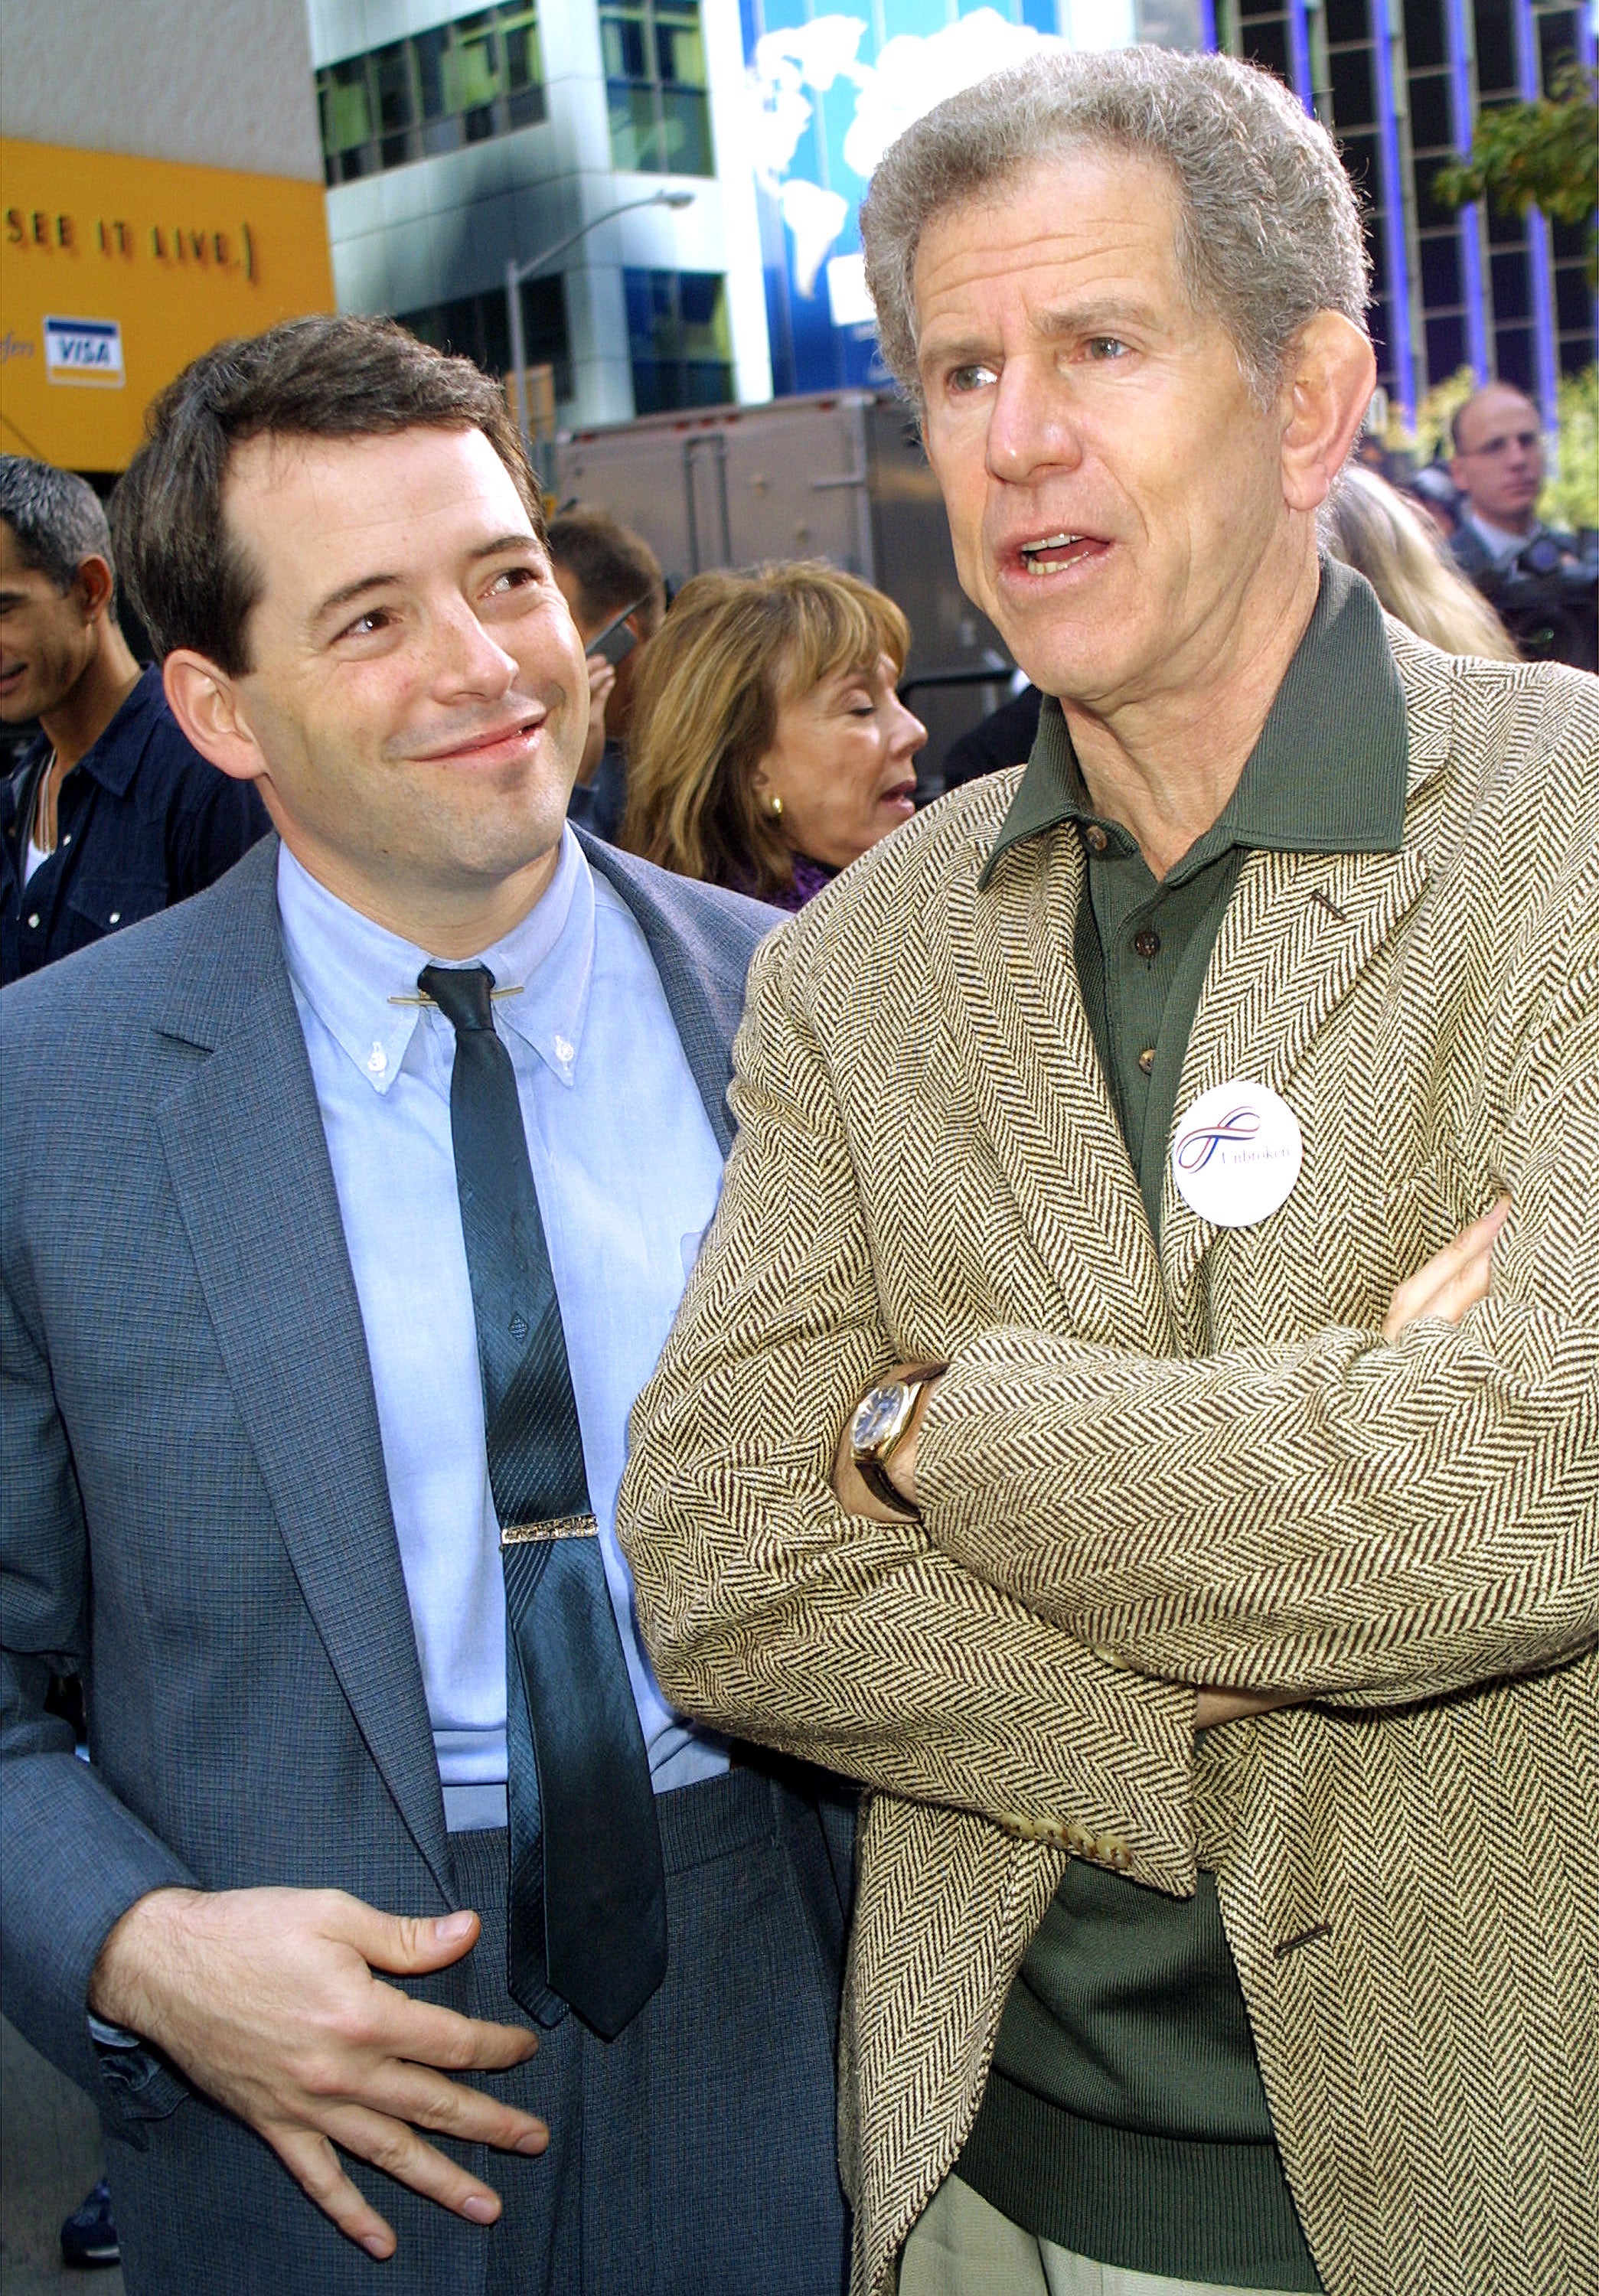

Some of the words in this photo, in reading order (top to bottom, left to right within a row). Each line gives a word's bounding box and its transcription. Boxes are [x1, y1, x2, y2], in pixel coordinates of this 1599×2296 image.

[6, 209, 71, 246] SEE
[96, 217, 126, 253] IT
[59, 338, 109, 363] VISA
